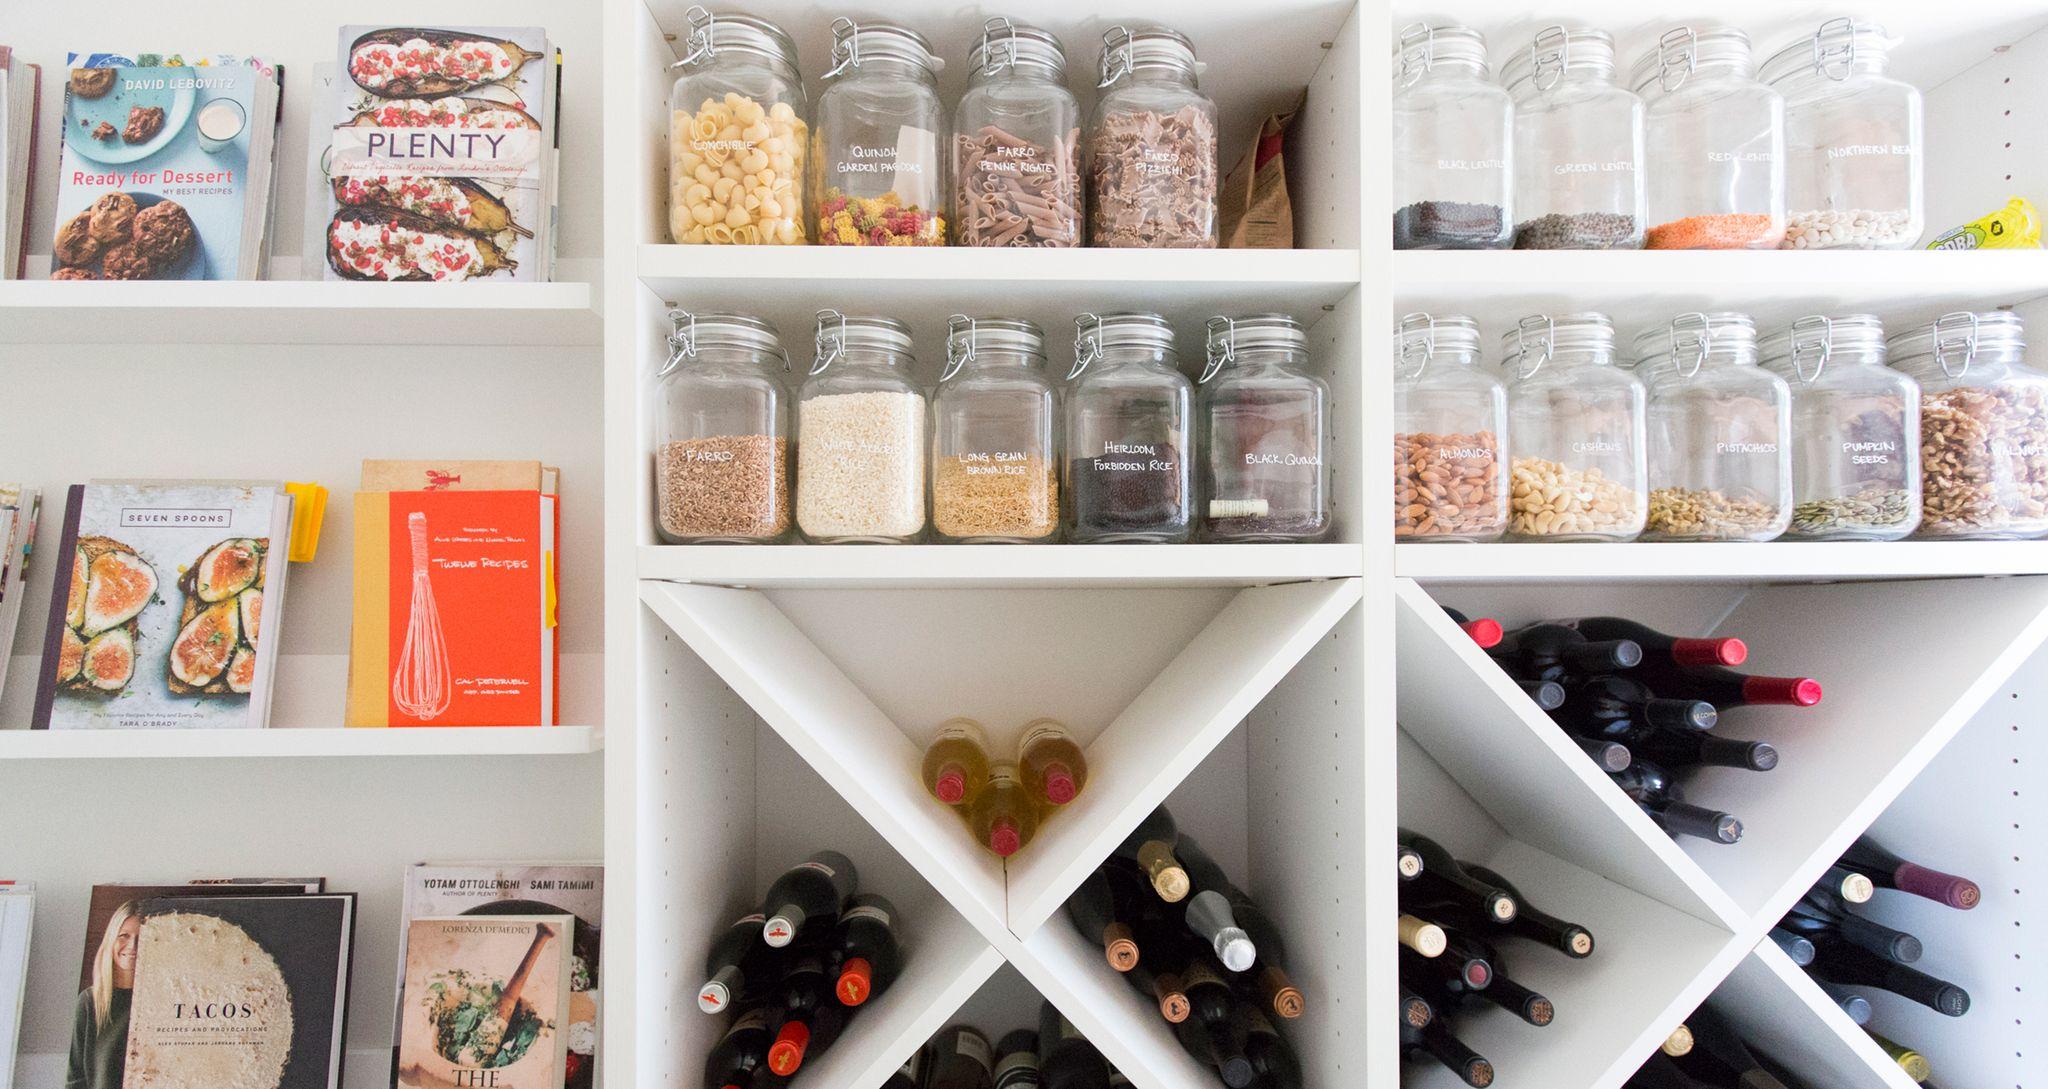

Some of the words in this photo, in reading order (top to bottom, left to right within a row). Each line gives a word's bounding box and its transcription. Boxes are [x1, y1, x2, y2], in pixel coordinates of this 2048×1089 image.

[125, 79, 165, 91] DAVID
[169, 78, 235, 90] LEBOVITZ
[368, 133, 506, 158] PLENTY
[852, 145, 897, 158] QUINOA
[997, 146, 1035, 158] FARRO
[1144, 149, 1180, 162] FARRO
[1707, 151, 1733, 163] RED
[1827, 144, 1888, 160] NORTHERN
[837, 161, 878, 173] GARDEN
[980, 160, 1016, 171] PENNE
[1020, 161, 1053, 173] RIGATE
[1438, 159, 1469, 170] BLACK
[1554, 161, 1597, 174] GREEN
[73, 171, 125, 188] Ready
[131, 170, 156, 184] for
[163, 169, 233, 184] Dessert
[1572, 442, 1622, 453] CASHEWS
[1716, 442, 1777, 455] PISTACHIOS
[1842, 441, 1895, 453] PUMPKIN
[686, 449, 734, 462] FARRO
[958, 452, 989, 463] LONG
[995, 451, 1027, 463] GRAIN
[1245, 453, 1284, 465] BLACK
[1439, 448, 1491, 459] ALMONDS
[1094, 459, 1145, 471] FORBIDDEN
[1149, 459, 1173, 471] RICE
[1851, 455, 1888, 465] SEEDS
[967, 465, 1002, 475] BROWN
[1004, 465, 1027, 475] RICE
[128, 514, 168, 523] SEVEN
[174, 514, 225, 523] SPOONS
[480, 557, 529, 570] RECIPES
[424, 879, 457, 889] YOTAM
[459, 879, 520, 889] OTTOLENGHI
[530, 880, 555, 890] SAMI
[558, 880, 594, 890] TAMIMI
[442, 926, 484, 934] LORENZA
[174, 1003, 252, 1019] TACOS
[452, 1069, 500, 1089] THE
